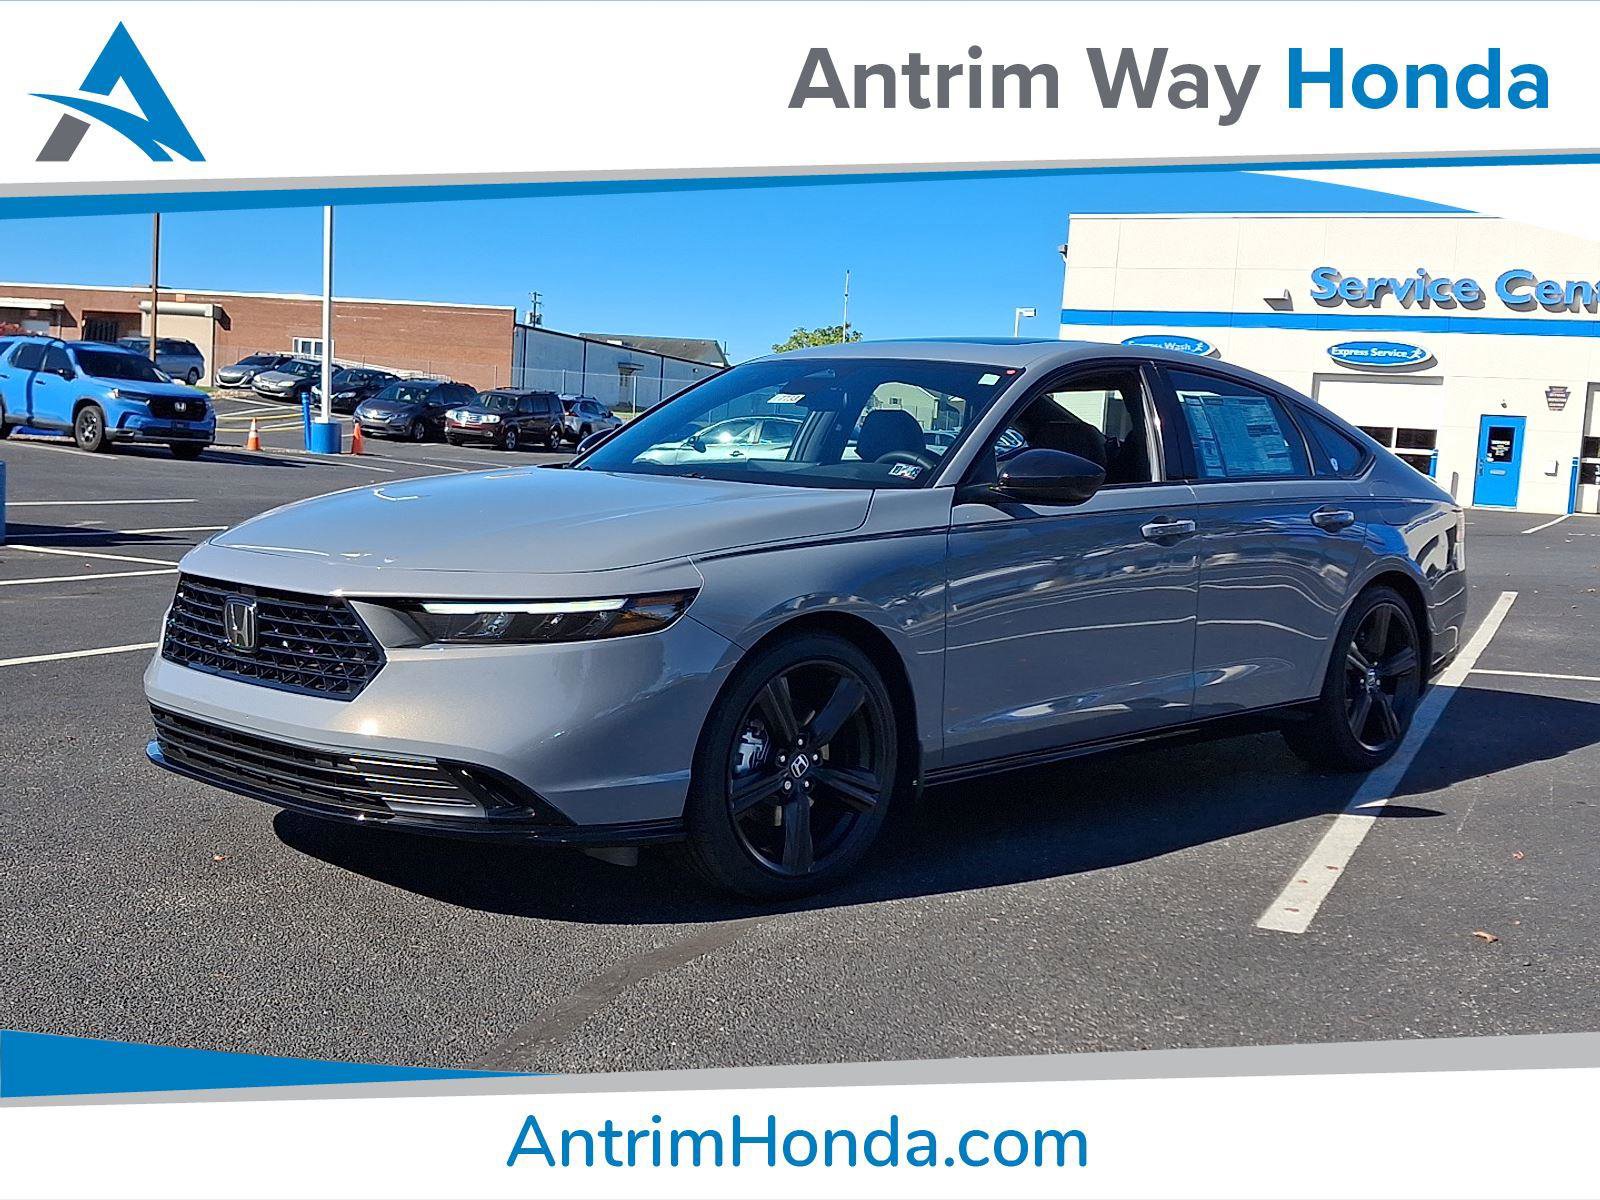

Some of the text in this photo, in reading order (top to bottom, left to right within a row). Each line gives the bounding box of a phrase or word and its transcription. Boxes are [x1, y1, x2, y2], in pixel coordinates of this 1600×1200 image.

[1310, 267, 1600, 305] Service Cen
[1163, 341, 1192, 351] Wash
[1331, 347, 1408, 358] Express Service
